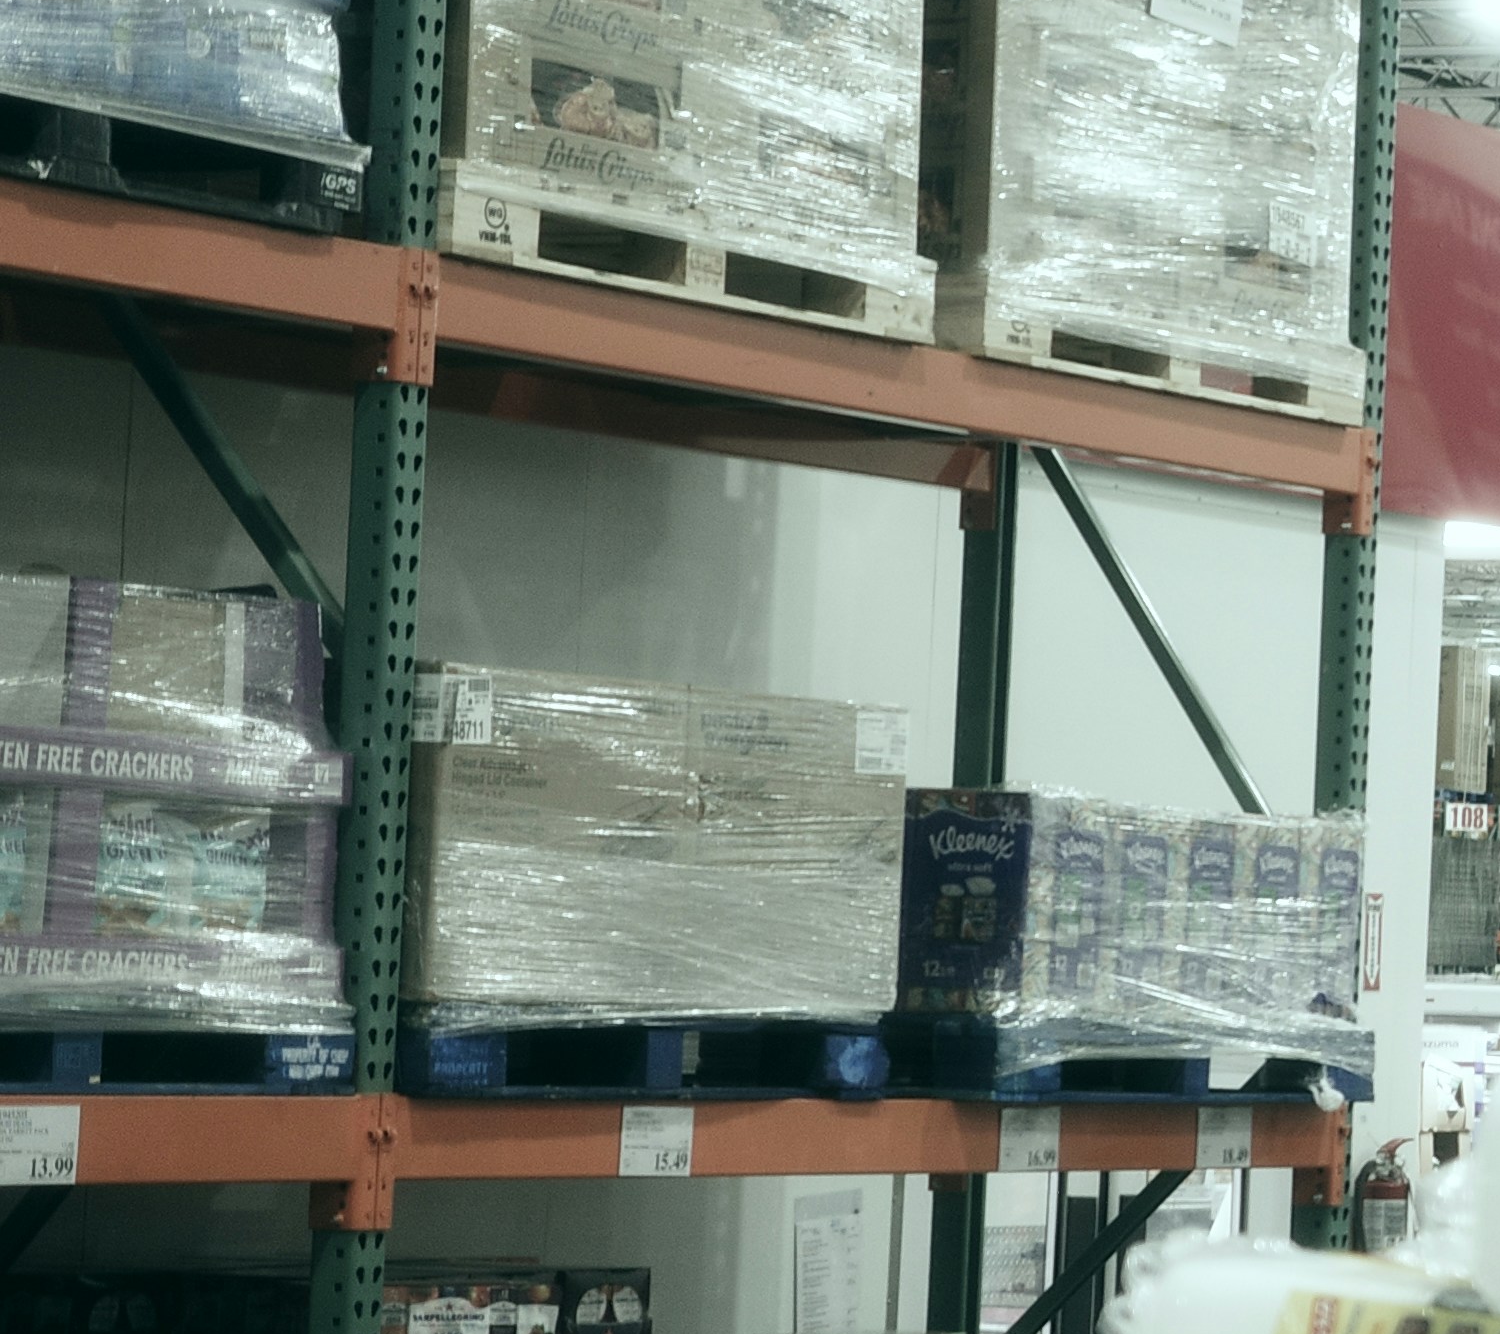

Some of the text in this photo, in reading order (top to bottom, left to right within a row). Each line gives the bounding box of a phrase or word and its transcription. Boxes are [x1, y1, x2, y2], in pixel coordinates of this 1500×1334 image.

[37, 742, 194, 782] FREE CRACKERS
[1451, 805, 1485, 829] 108
[927, 824, 1016, 862] Kleenex
[26, 949, 189, 976] FREE CRACKERS
[30, 1157, 74, 1179] 13.99
[653, 1152, 688, 1171] 15.49
